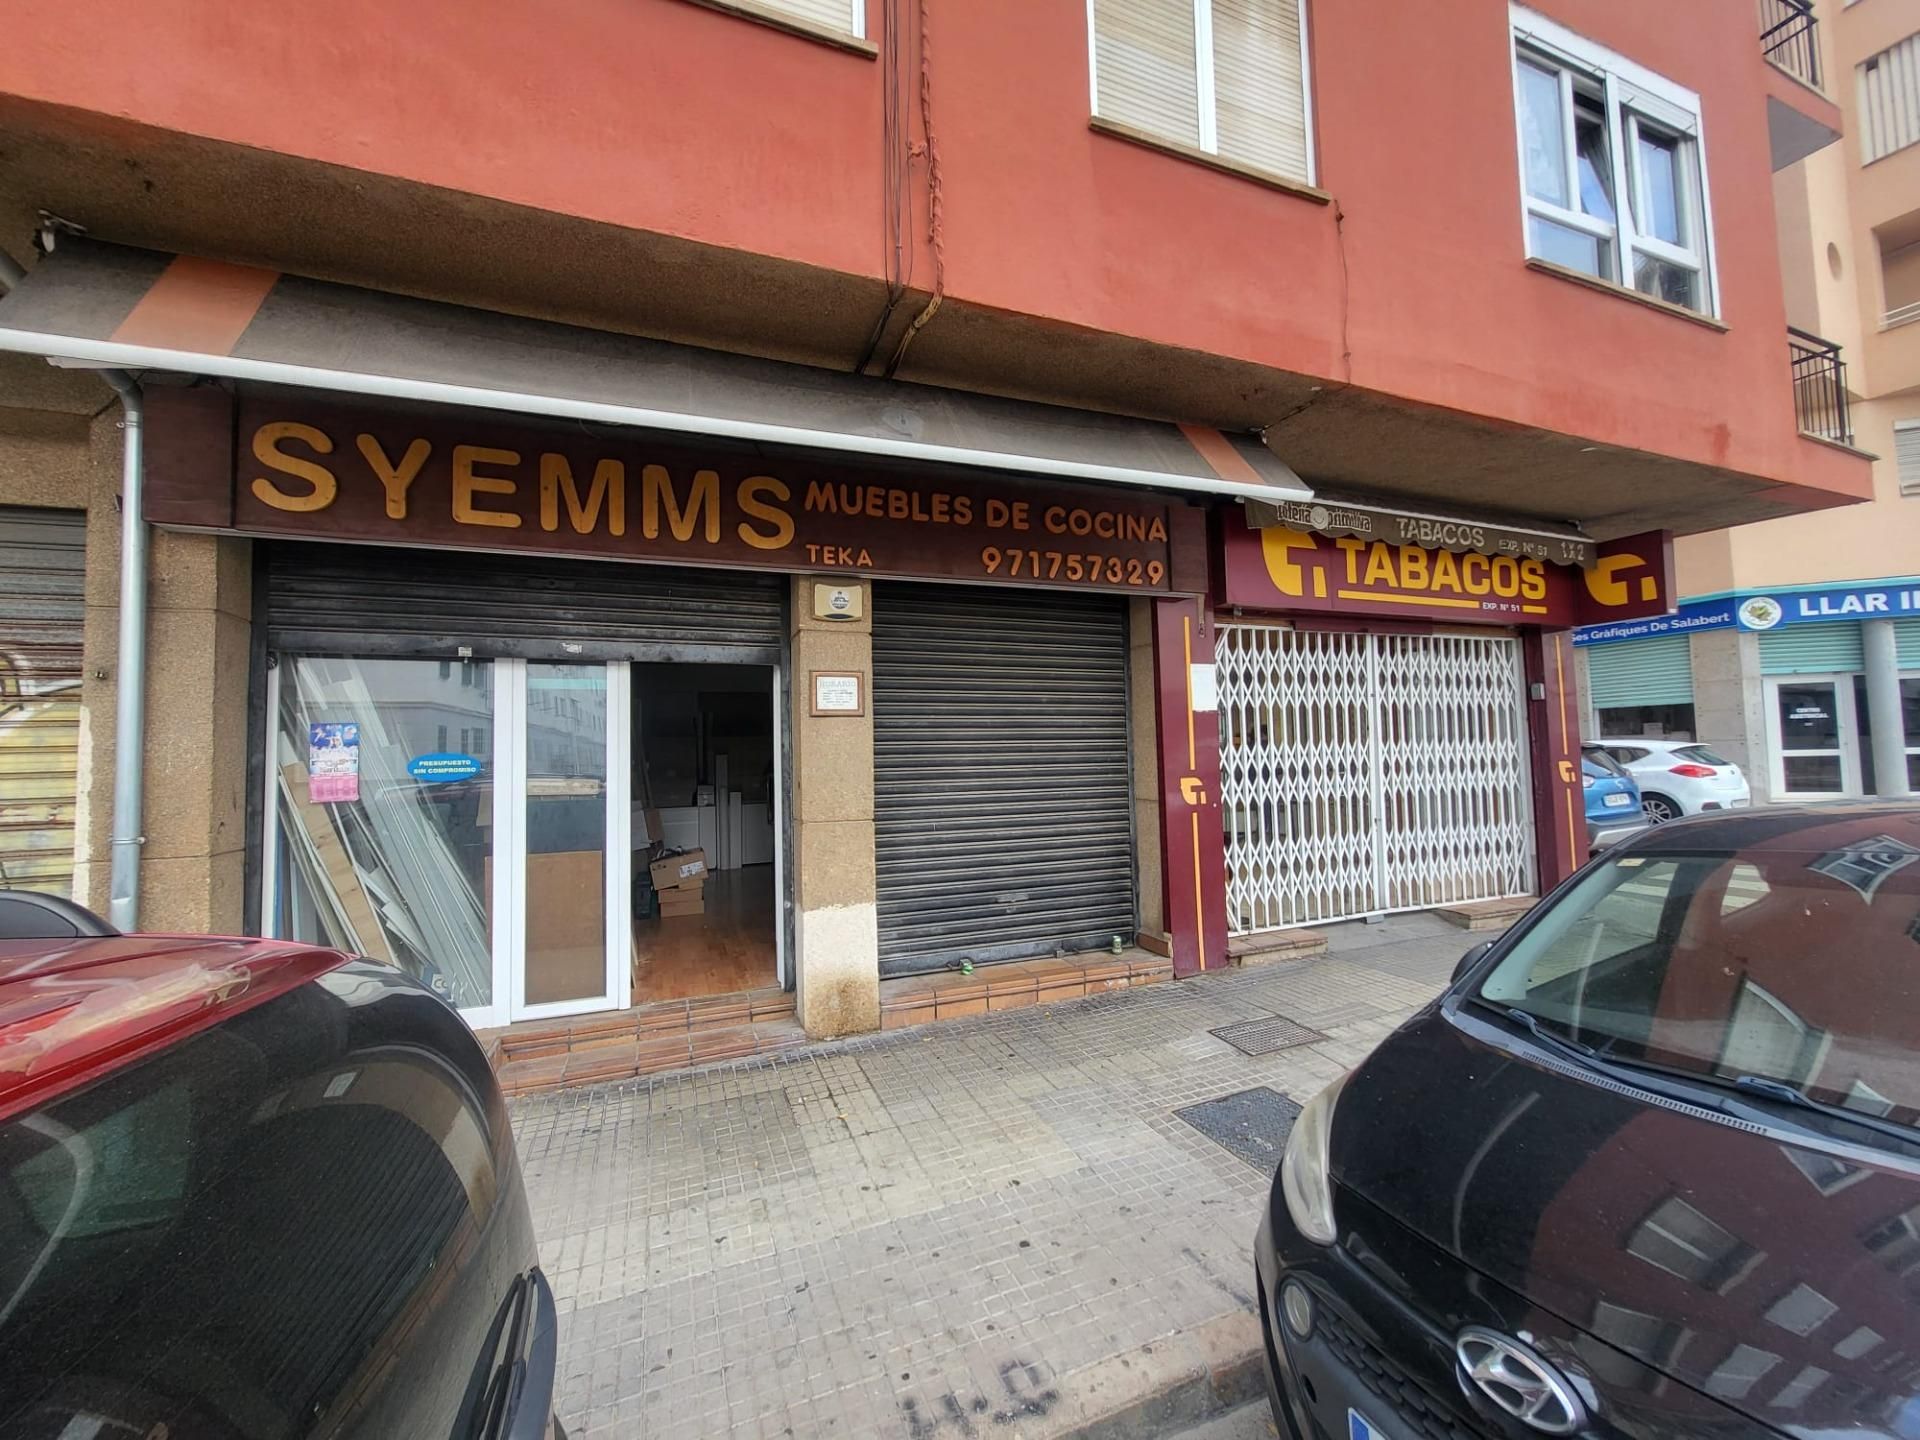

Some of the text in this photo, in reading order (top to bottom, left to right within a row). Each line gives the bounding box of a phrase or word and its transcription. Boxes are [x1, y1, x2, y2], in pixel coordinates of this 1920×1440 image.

[251, 421, 795, 550] SYEMMS
[804, 480, 1168, 543] MUEBLES DE COCINA
[805, 543, 873, 568] TEKA
[1396, 518, 1485, 547] TABACOS
[1537, 545, 1548, 556] 51
[982, 546, 1165, 585] 971757329
[1336, 538, 1547, 600] TABACOS
[1511, 604, 1520, 612] 51
[1650, 623, 1669, 632] De
[1671, 612, 1730, 629] Salabert
[1800, 593, 1889, 617] LLAR
